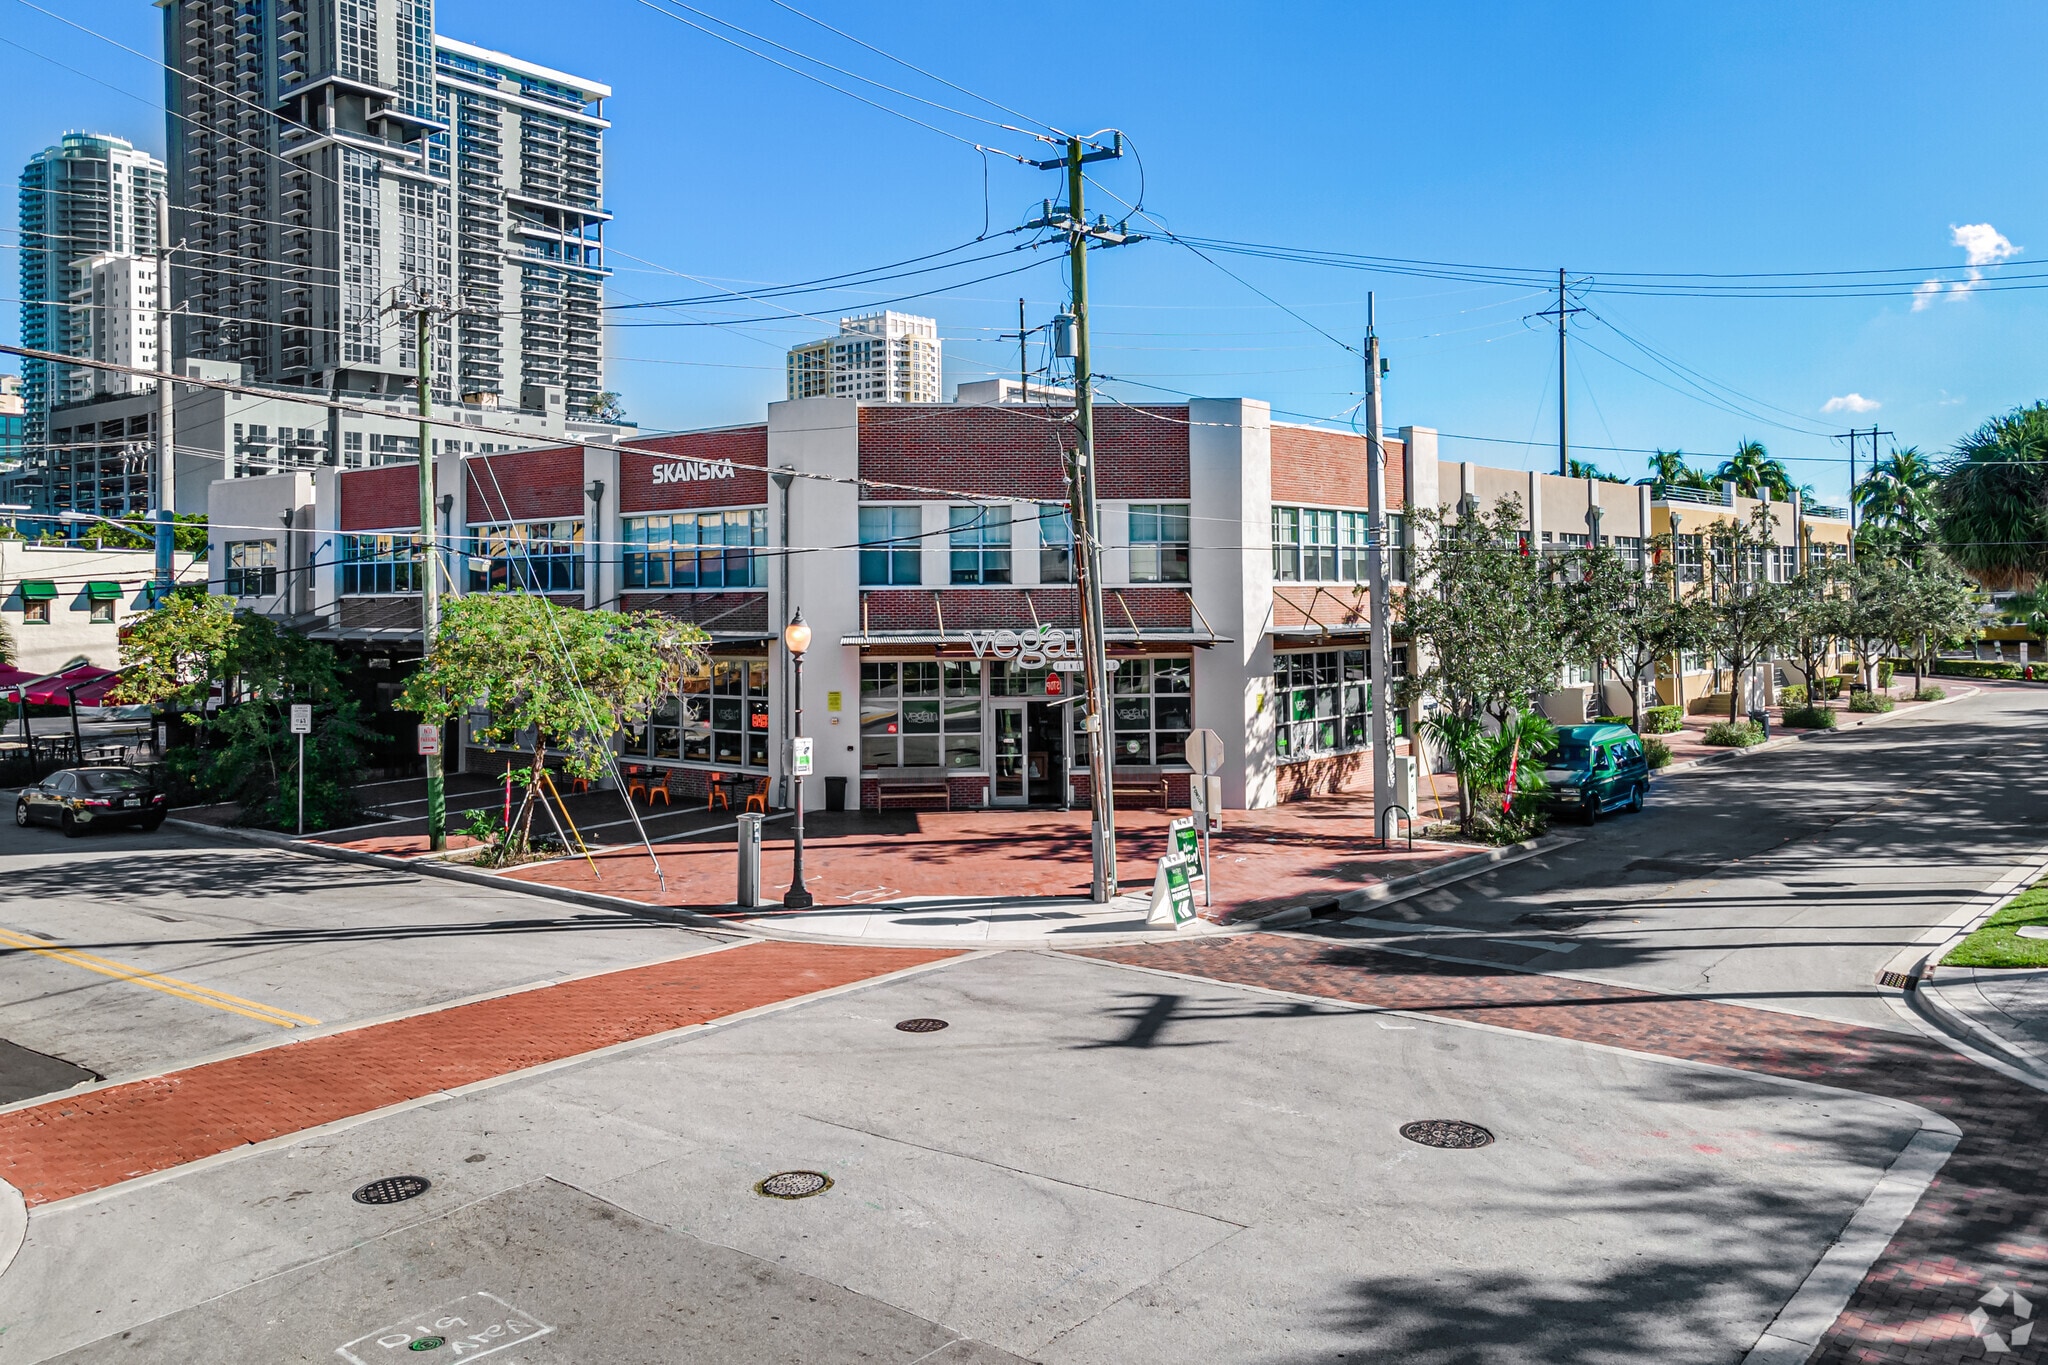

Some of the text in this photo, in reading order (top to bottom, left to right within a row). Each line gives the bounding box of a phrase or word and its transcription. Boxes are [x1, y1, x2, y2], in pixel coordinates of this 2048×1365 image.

[652, 458, 735, 484] SKANSKA
[904, 710, 938, 724] vegan
[1115, 707, 1149, 721] vegan
[377, 1316, 468, 1349] DIG
